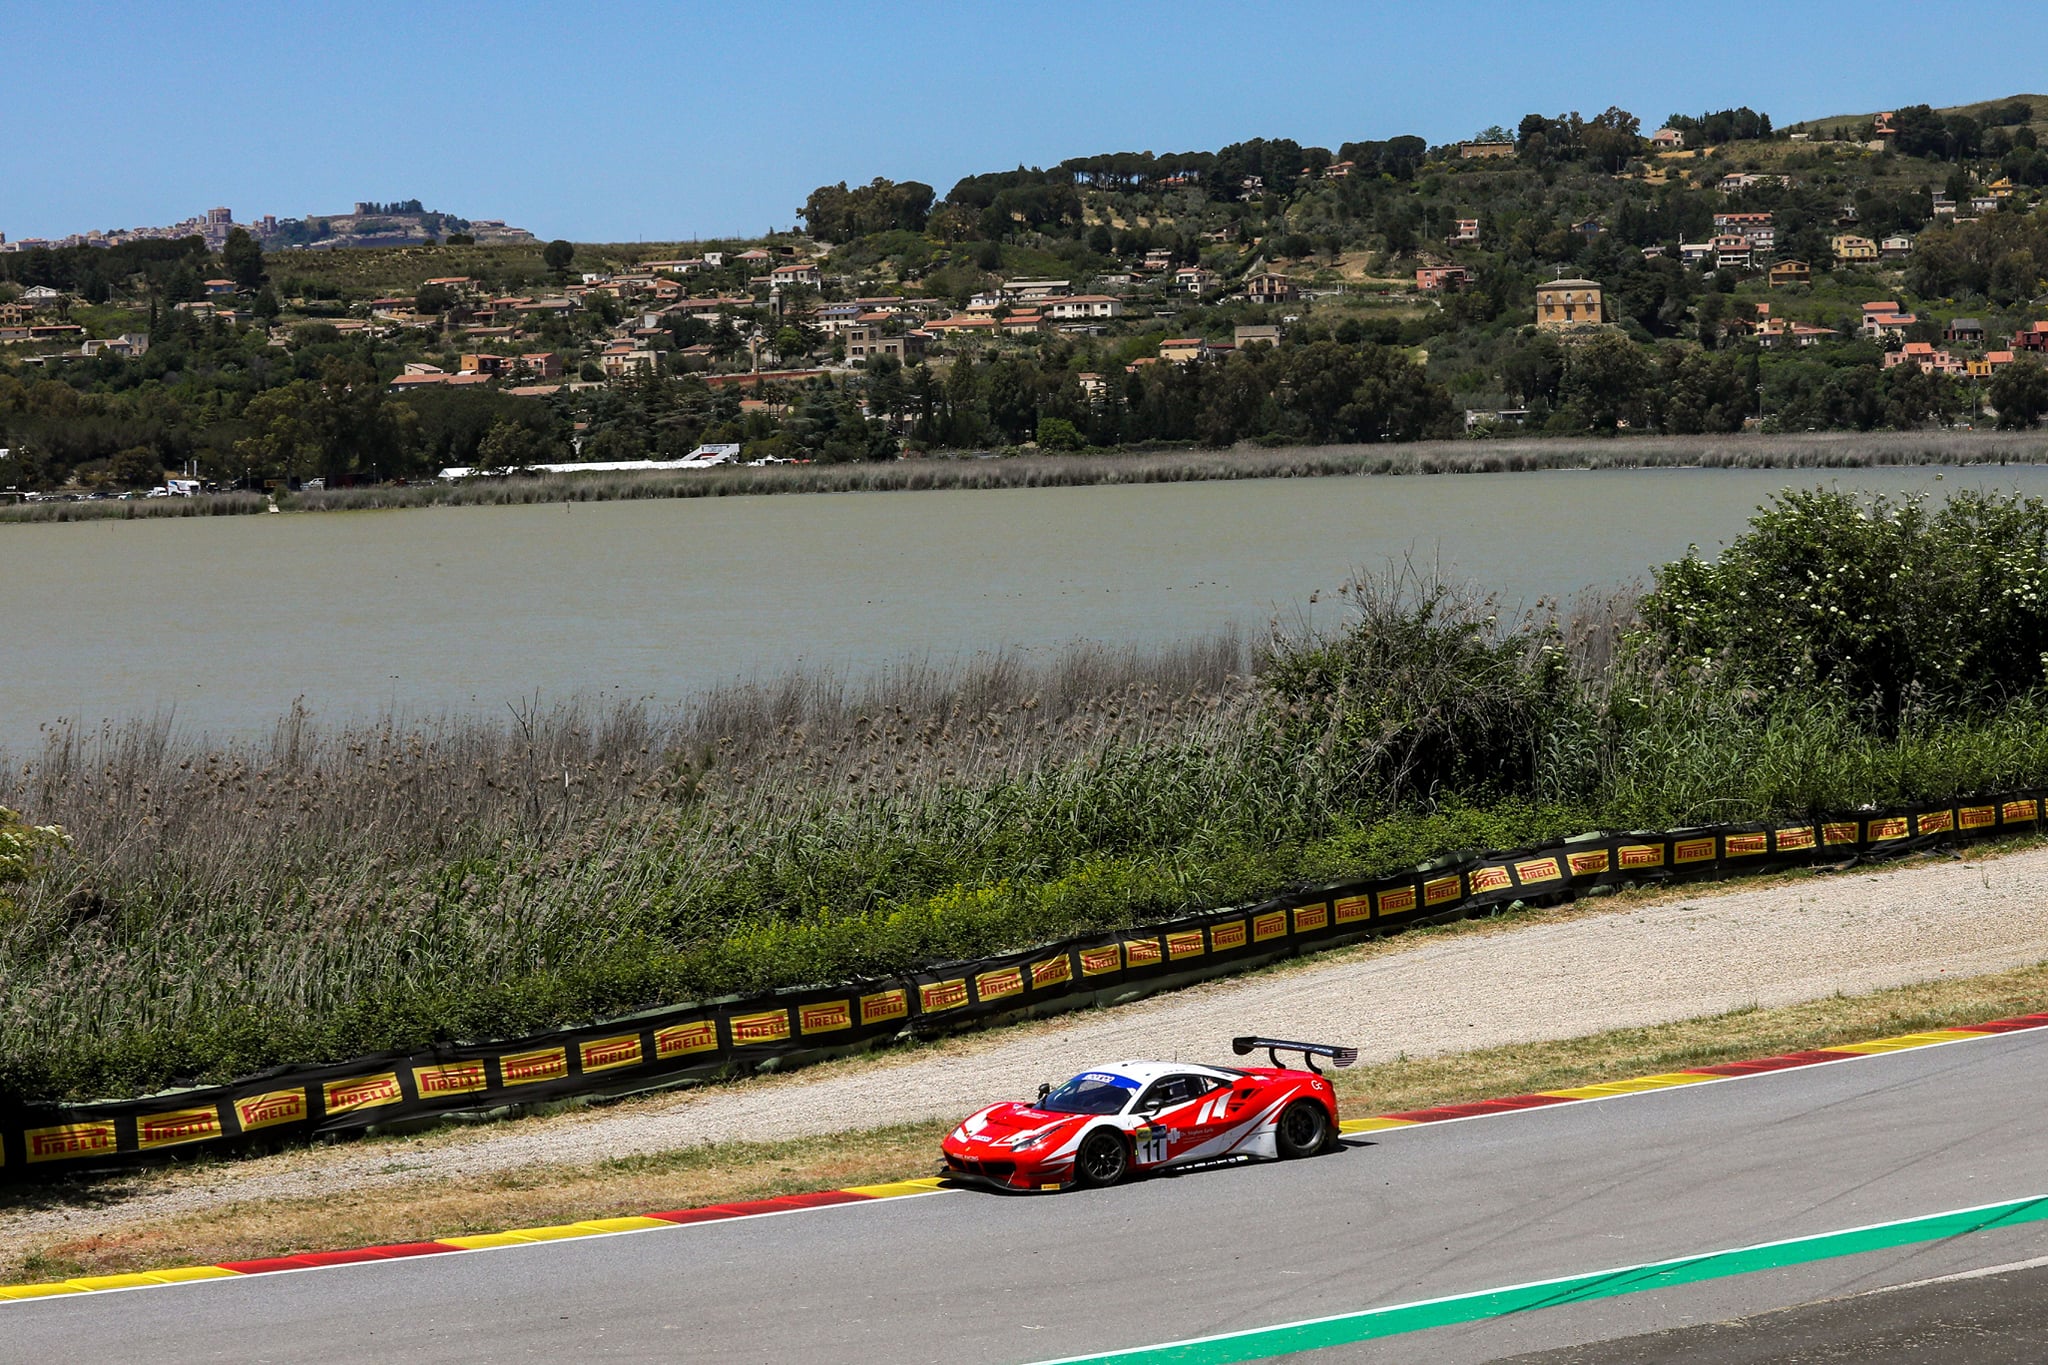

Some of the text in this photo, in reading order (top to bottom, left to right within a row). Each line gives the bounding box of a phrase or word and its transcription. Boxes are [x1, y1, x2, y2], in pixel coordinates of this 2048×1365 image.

[1729, 837, 1763, 852] PIRELLI
[1780, 831, 1812, 847] PIRELLI
[1622, 847, 1660, 864] PIRELLI
[1677, 842, 1712, 858] PIRELLI
[1520, 862, 1556, 880] PIRELLI
[1572, 854, 1606, 871] PIRELLI
[1473, 871, 1507, 889] PIRELLI
[1381, 891, 1413, 910] PIRELLI
[1427, 881, 1458, 900] PIRELLI
[1297, 908, 1325, 927] PIRELLI
[1337, 900, 1366, 918] PIRELLI
[1214, 926, 1243, 945] PIRELLI
[1256, 916, 1284, 935] PIRELLI
[1129, 944, 1159, 961] PIRELLI
[1170, 936, 1201, 954] PIRELLI
[1085, 950, 1118, 970] PIRELLI
[1035, 960, 1068, 983] PIRELLI
[980, 974, 1019, 995] PIRELLI
[925, 985, 964, 1007] PIRELLI
[803, 1006, 846, 1028] PIRELLI
[864, 996, 903, 1018] PIRELLI
[736, 1016, 785, 1039] PIRELLI
[661, 1027, 711, 1052] PIRELLI
[586, 1041, 637, 1066] PIRELLI
[507, 1054, 562, 1079] PIRELLI
[421, 1067, 480, 1091] PIRELLI
[331, 1080, 394, 1107] PIRELLI
[242, 1095, 300, 1124] PIRELLI
[144, 1113, 213, 1141] PIRELLI
[33, 1128, 107, 1155] PIRELLI
[1143, 1140, 1160, 1162] 11
